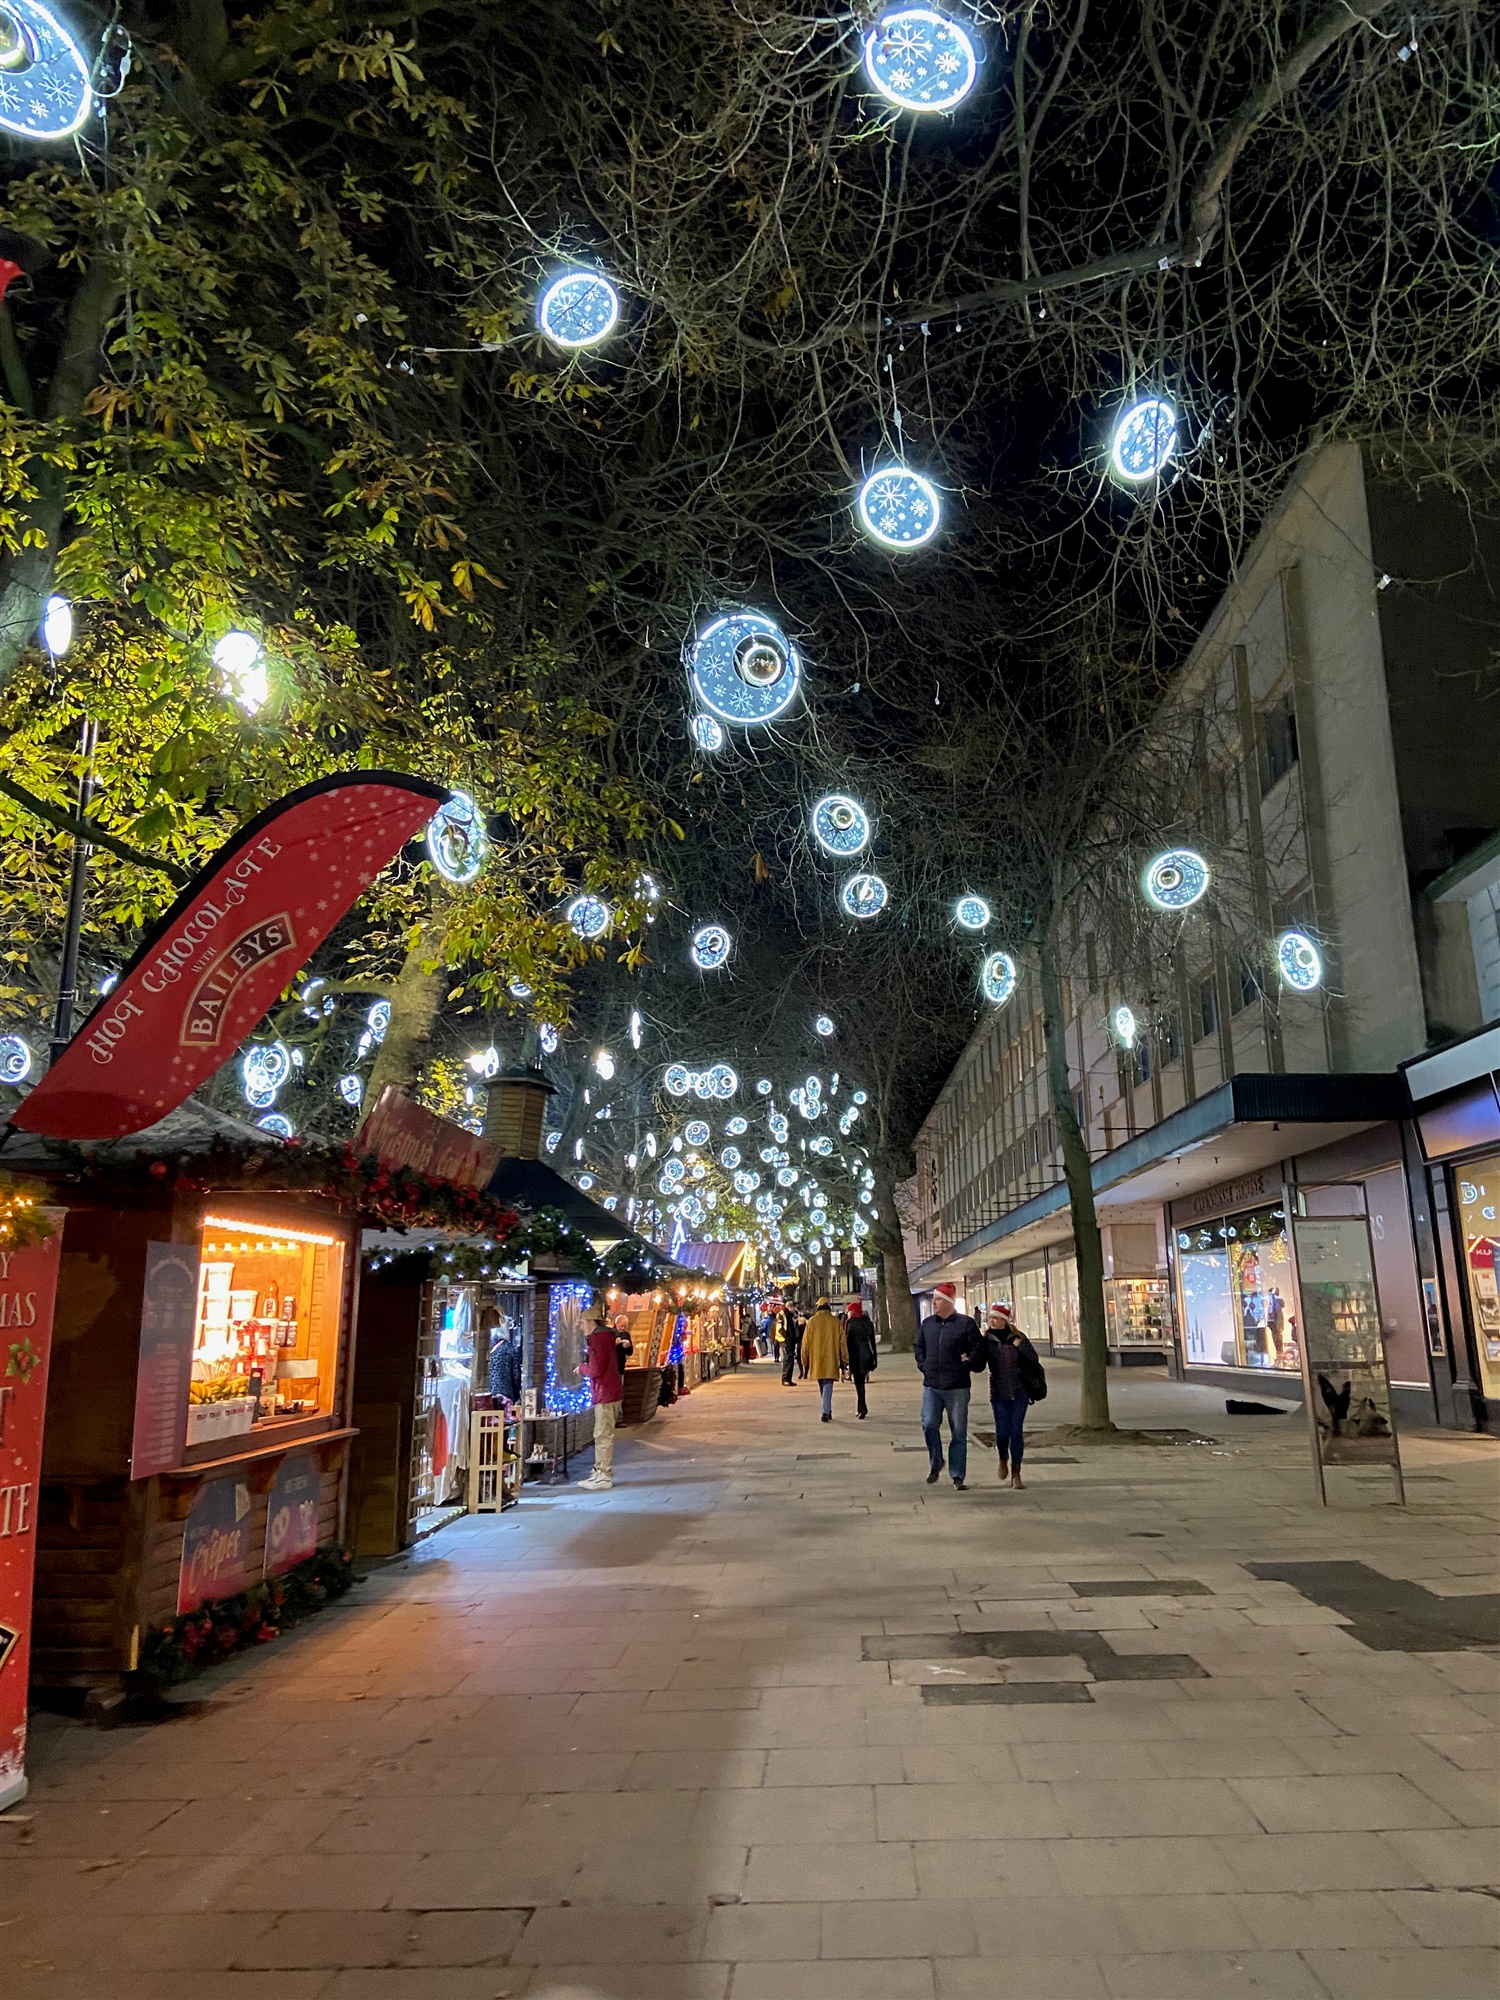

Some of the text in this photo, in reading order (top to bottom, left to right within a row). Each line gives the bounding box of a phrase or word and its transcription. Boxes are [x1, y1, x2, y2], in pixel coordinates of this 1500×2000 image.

[85, 836, 283, 1064] HOT CHOCOLATE
[189, 924, 284, 1036] BAILEYS
[191, 946, 218, 974] WITH
